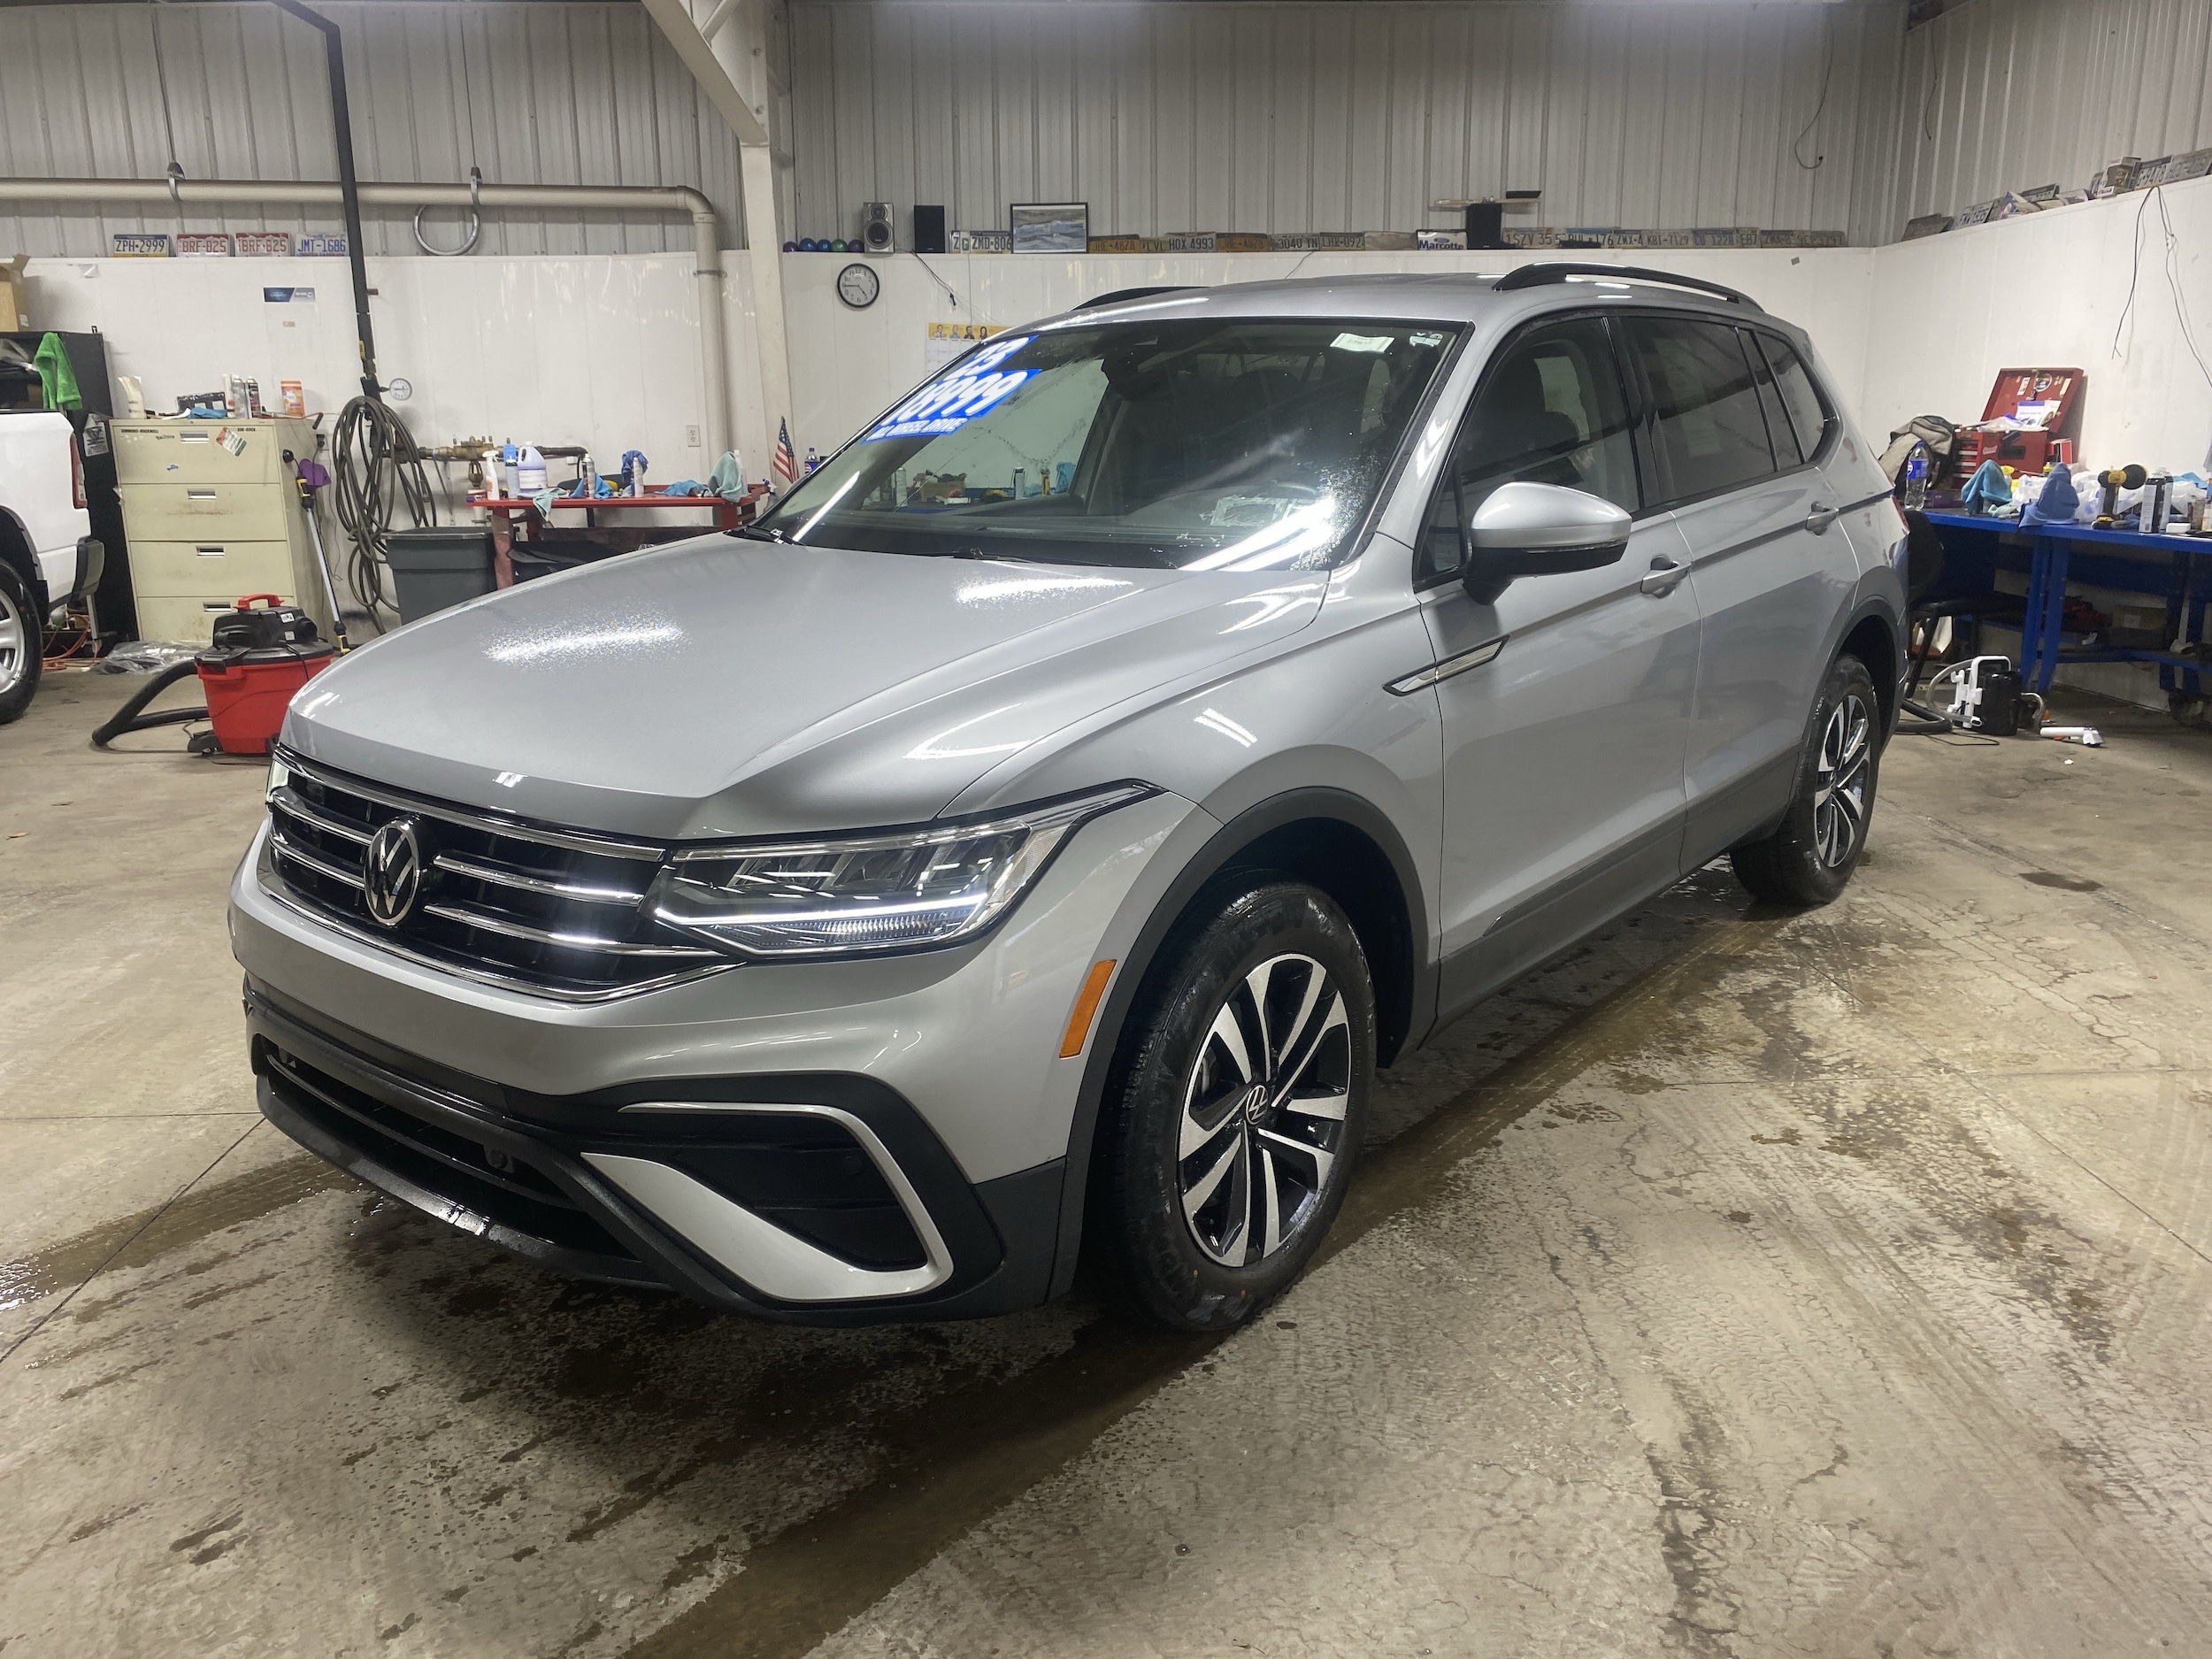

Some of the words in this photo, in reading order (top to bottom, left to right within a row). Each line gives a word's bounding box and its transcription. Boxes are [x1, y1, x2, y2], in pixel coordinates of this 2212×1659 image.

[1190, 237, 1214, 250] 4993
[1418, 239, 1464, 250] Marcotte
[943, 336, 1030, 382] 23
[919, 417, 969, 434] DRIVE
